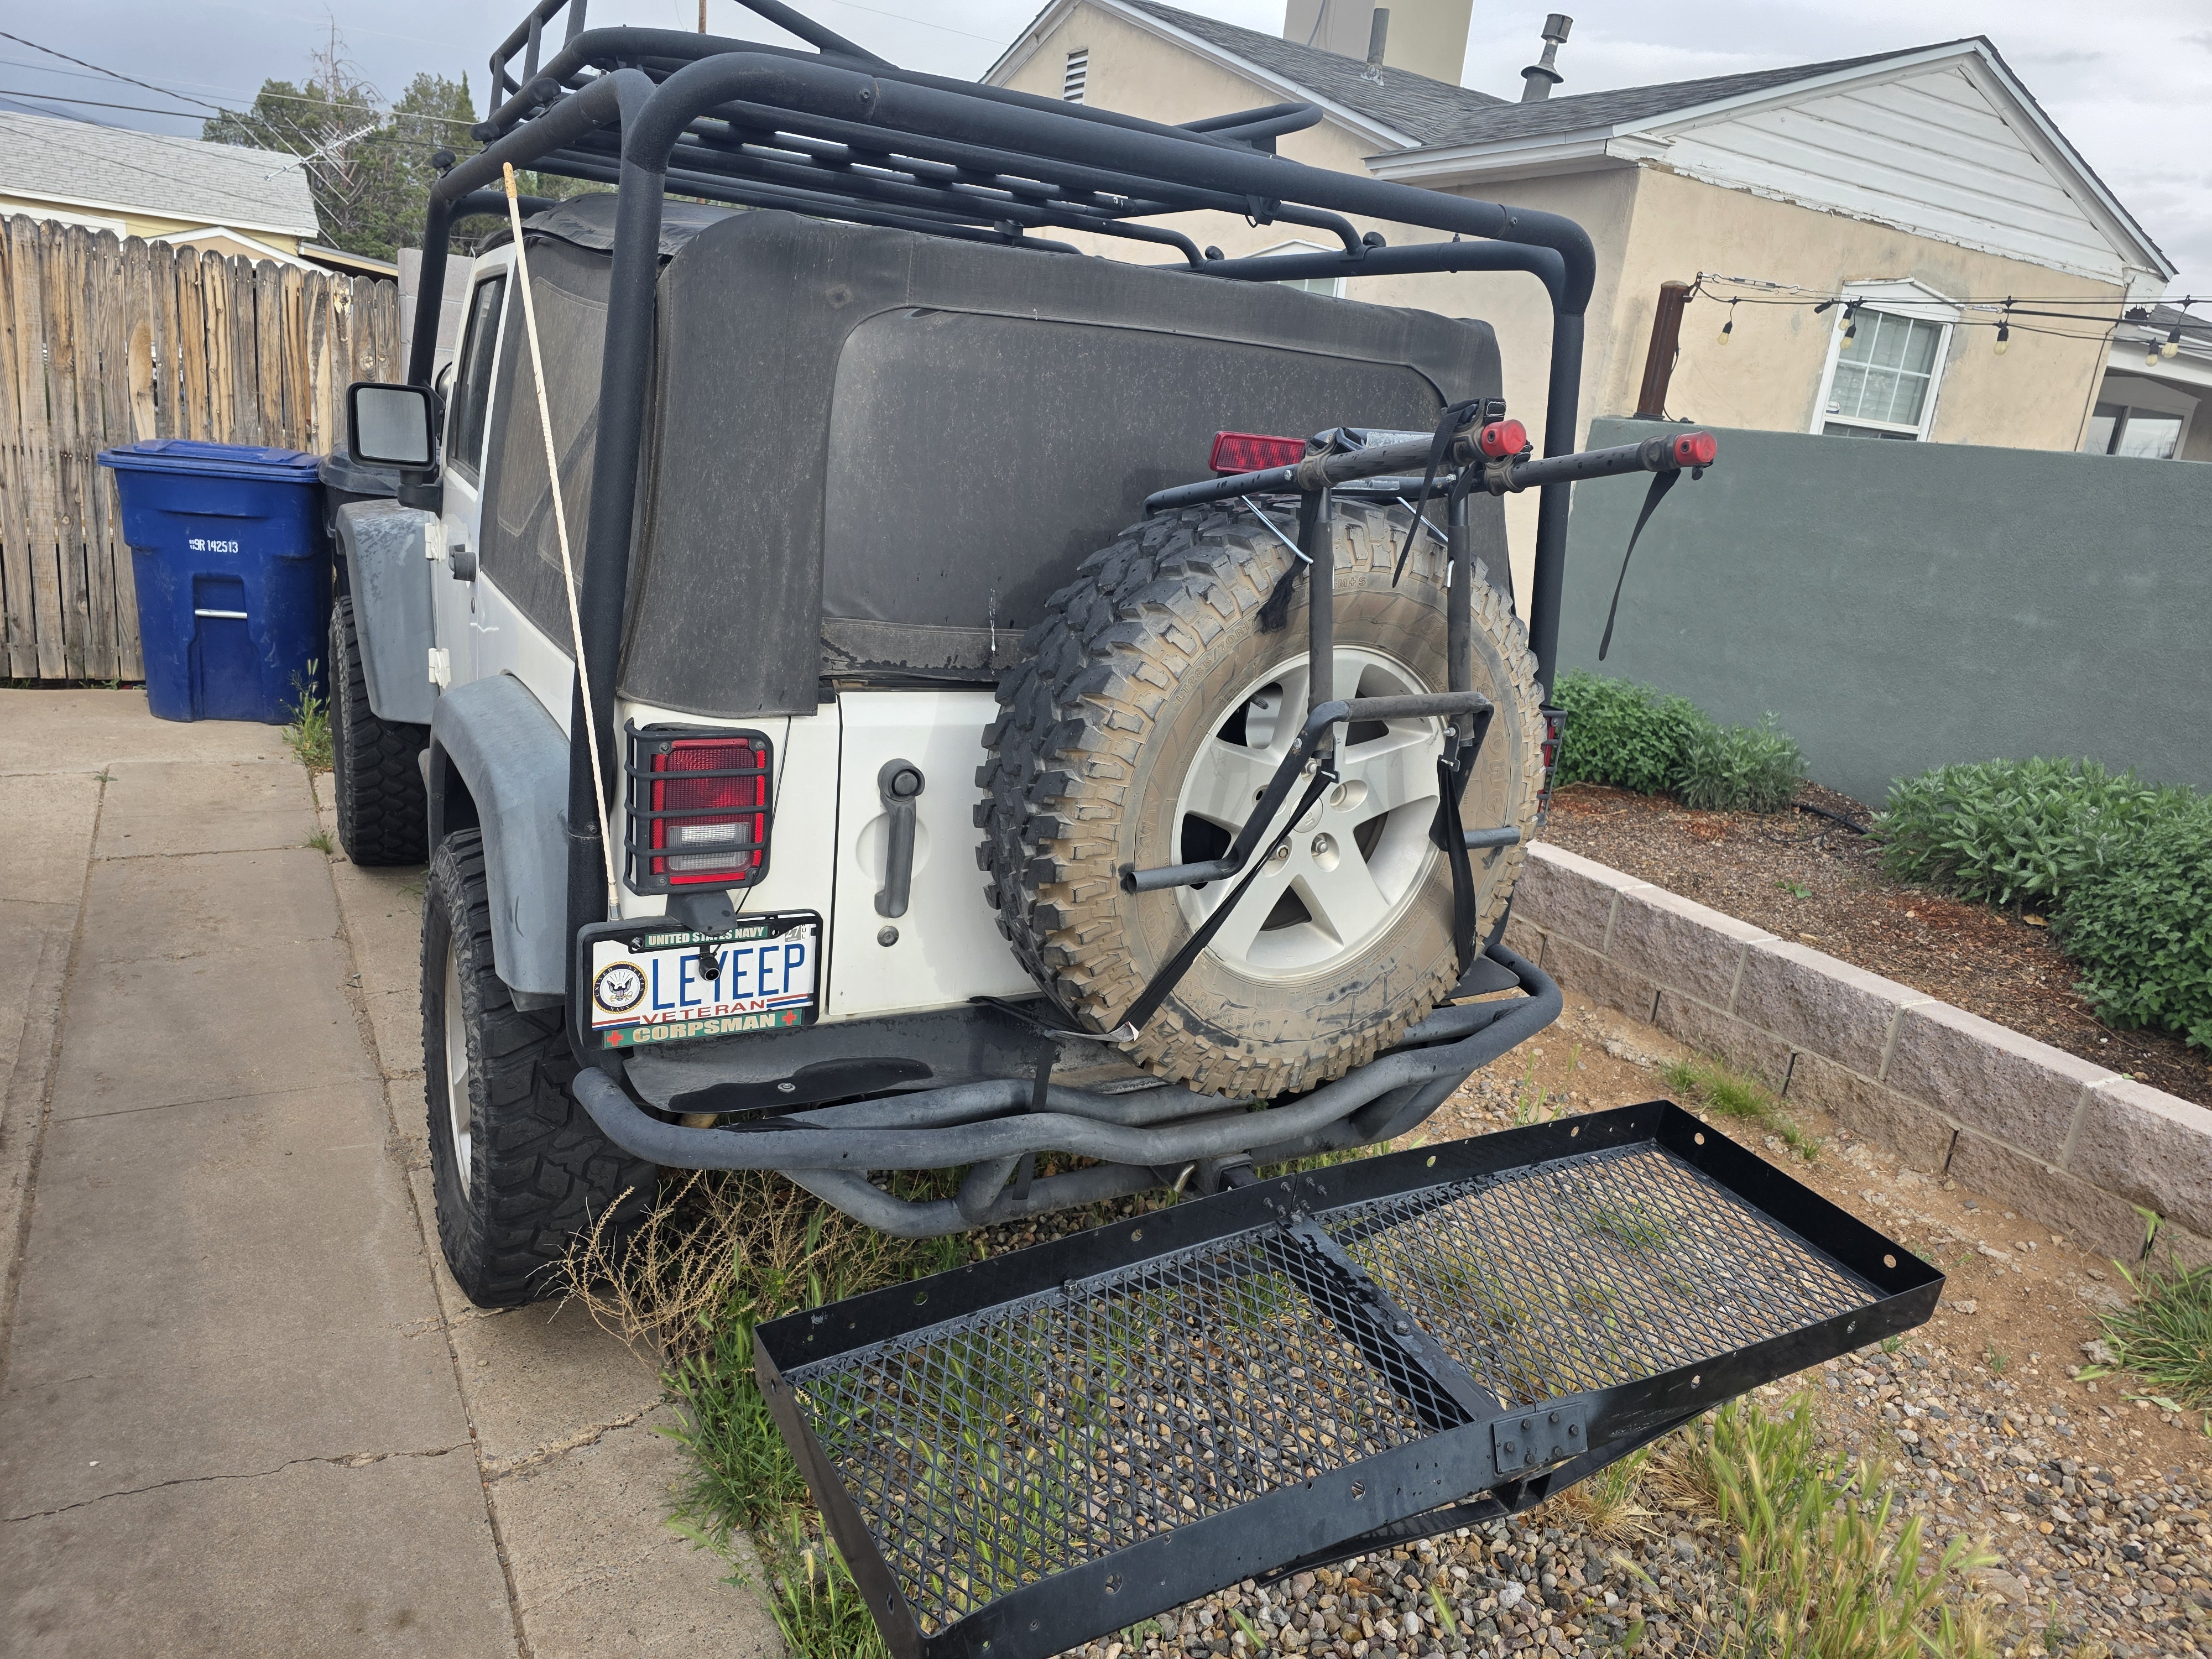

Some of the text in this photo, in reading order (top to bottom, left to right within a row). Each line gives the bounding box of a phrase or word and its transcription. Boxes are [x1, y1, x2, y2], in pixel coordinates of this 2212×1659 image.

[194, 539, 205, 551] 9R
[207, 540, 238, 554] 142513
[648, 926, 765, 946] UNITED STES NAVY
[785, 925, 800, 938] 27
[652, 943, 806, 1011] LEYEEP
[641, 999, 766, 1024] VETERAN
[632, 1013, 775, 1043] CORPSMAN
